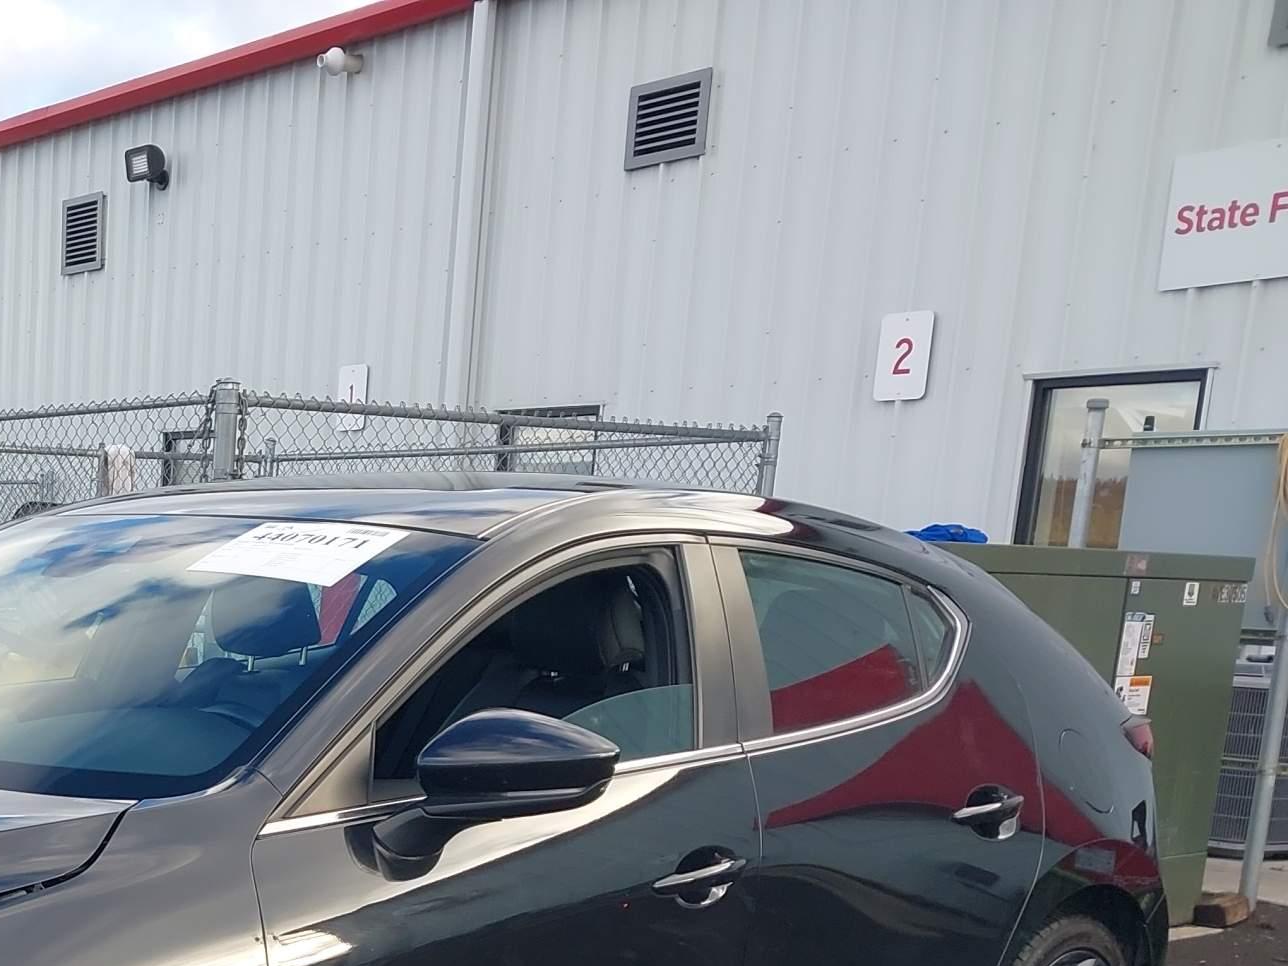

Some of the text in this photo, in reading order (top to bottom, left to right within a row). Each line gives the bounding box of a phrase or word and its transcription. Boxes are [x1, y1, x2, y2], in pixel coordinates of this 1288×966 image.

[1174, 199, 1260, 236] State
[892, 337, 914, 375] 2
[253, 532, 370, 549] 44070171
